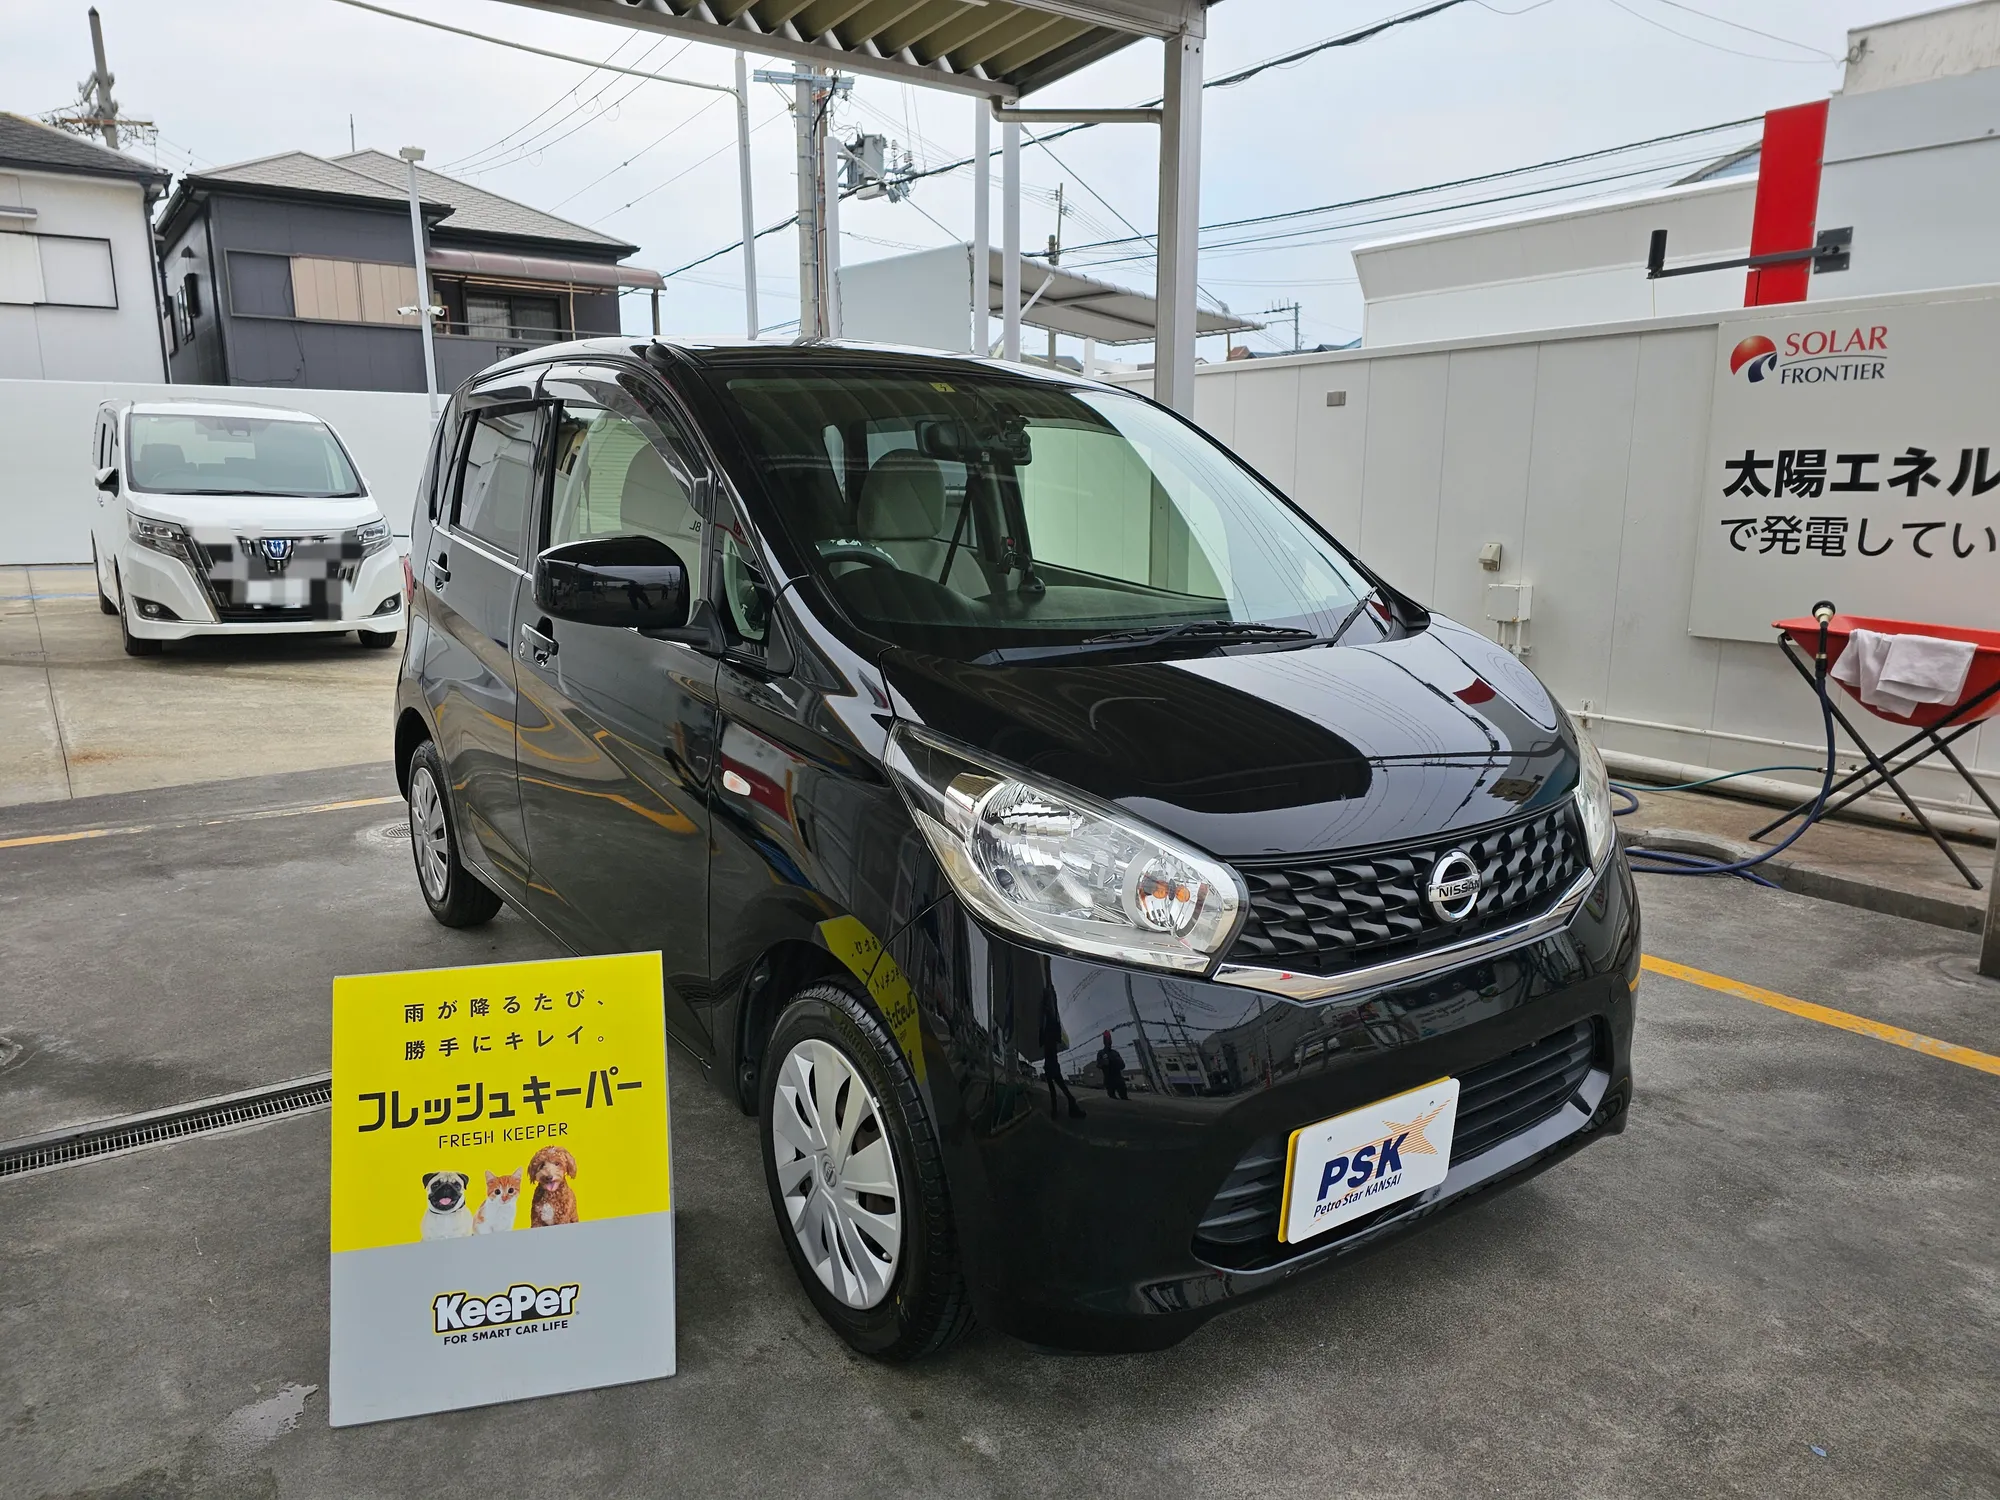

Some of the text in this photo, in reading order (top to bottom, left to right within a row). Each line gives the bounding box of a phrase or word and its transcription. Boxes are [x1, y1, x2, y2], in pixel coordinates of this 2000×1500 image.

[1784, 326, 1888, 357] SOLAR
[1781, 362, 1886, 385] FRONTIER
[1722, 446, 2000, 498] 太陽エネル
[1720, 514, 1996, 559] で発電してい
[1438, 880, 1480, 898] NISSAN
[403, 988, 605, 1024] 雨が降るたび、
[403, 1025, 605, 1061] 勝手にキレイ。
[358, 1065, 643, 1133] フレッシュキーパー
[438, 1121, 569, 1149] FRESH KEEPER
[1316, 1131, 1410, 1202] PSK
[1313, 1172, 1403, 1218] Petro Star KANSAI
[433, 1284, 579, 1333] KeePer
[443, 1319, 569, 1346] FOR SMART CAR LIFE
